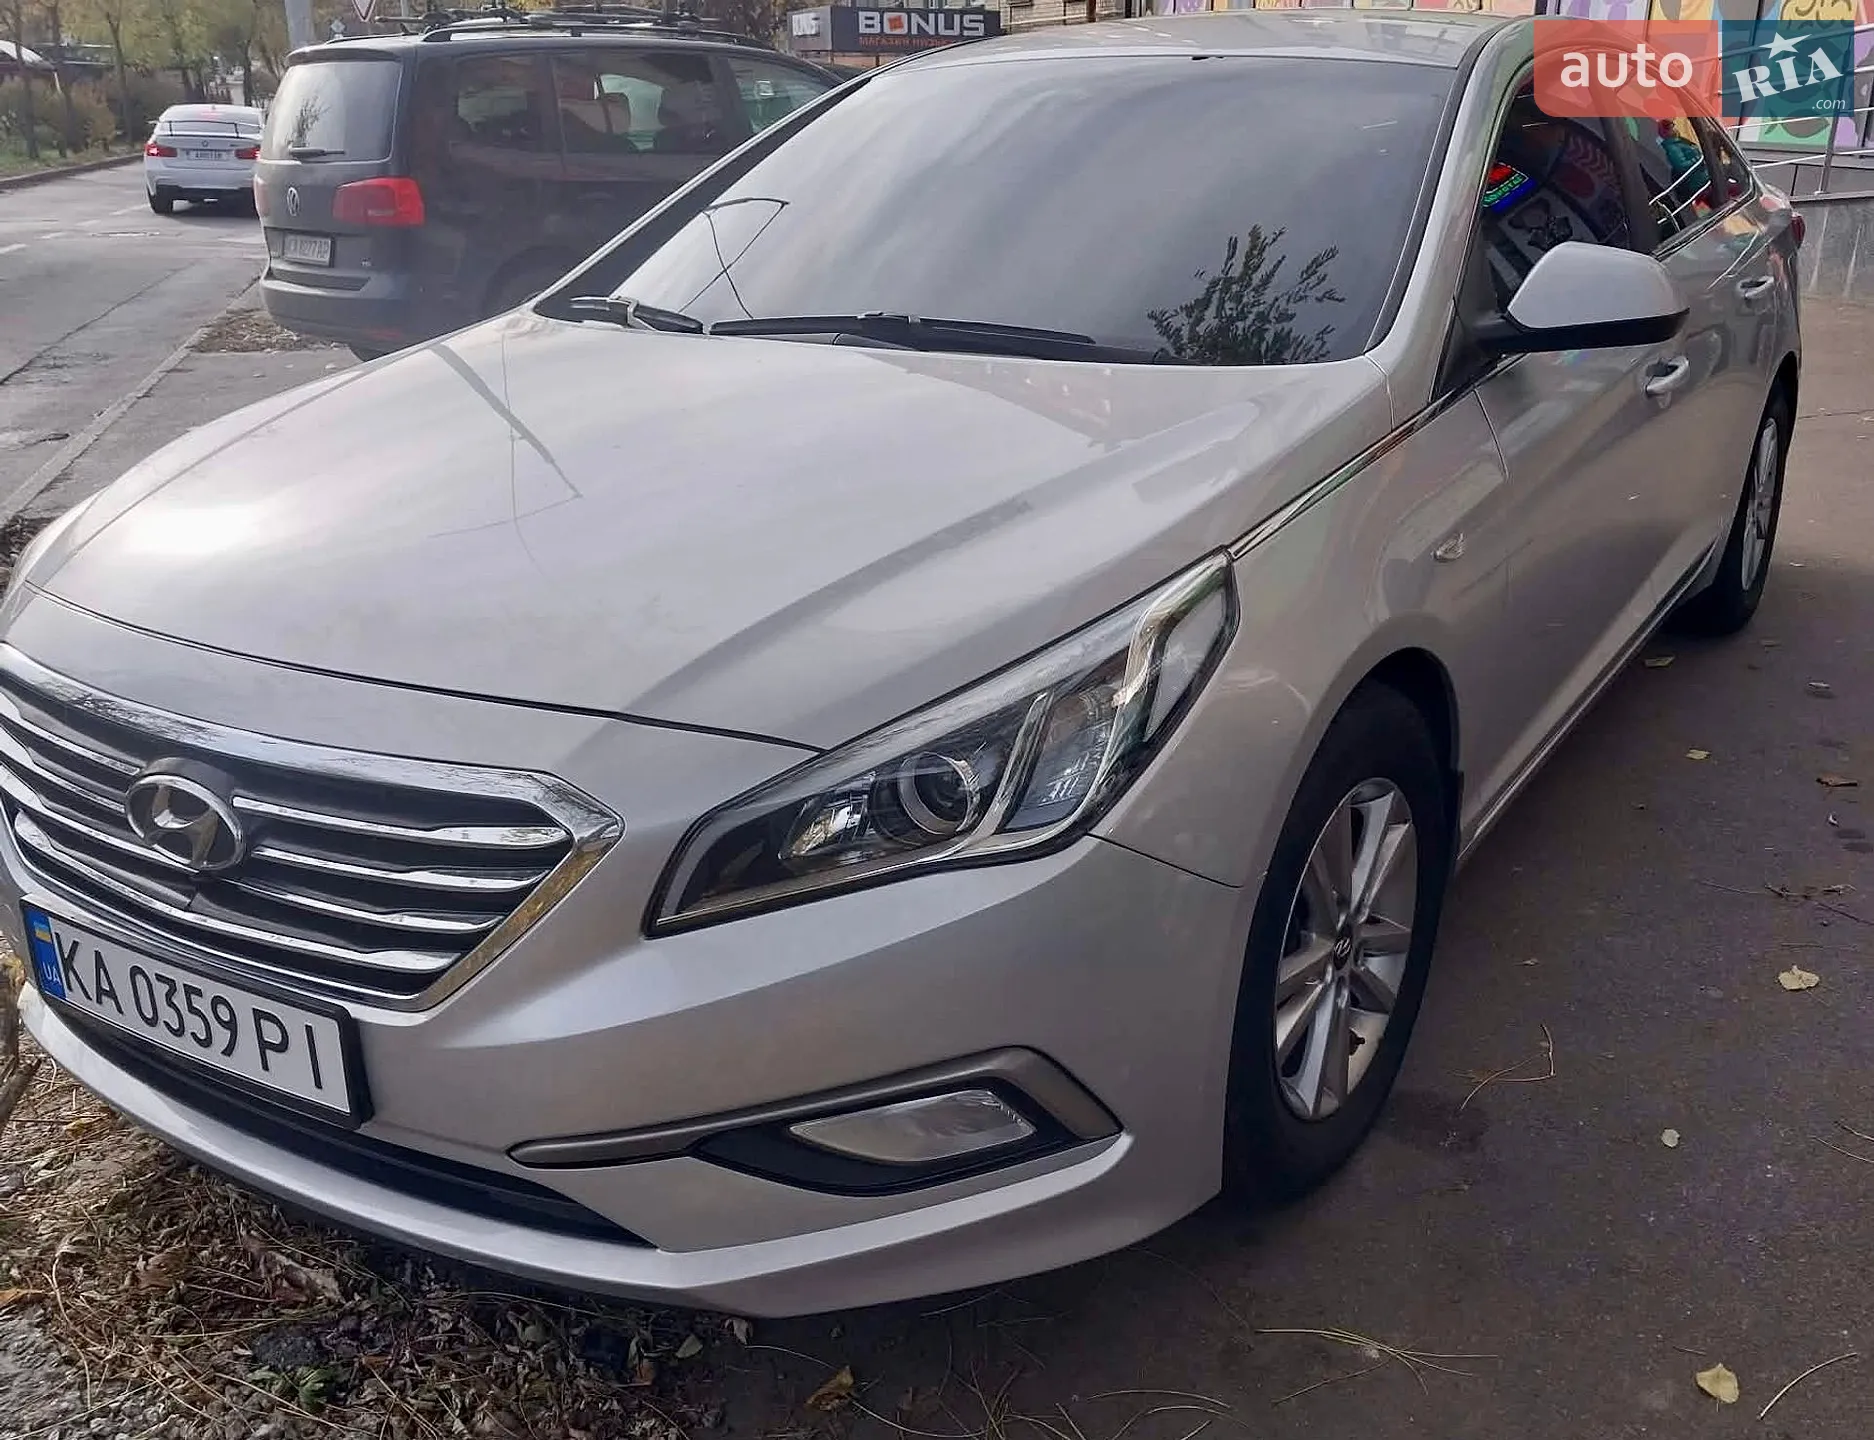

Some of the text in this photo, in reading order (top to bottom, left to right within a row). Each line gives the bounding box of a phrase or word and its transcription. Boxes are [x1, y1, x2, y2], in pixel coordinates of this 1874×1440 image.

[859, 11, 984, 36] BONUS
[43, 961, 62, 986] UA
[56, 932, 323, 1090] KA 0359 PI
